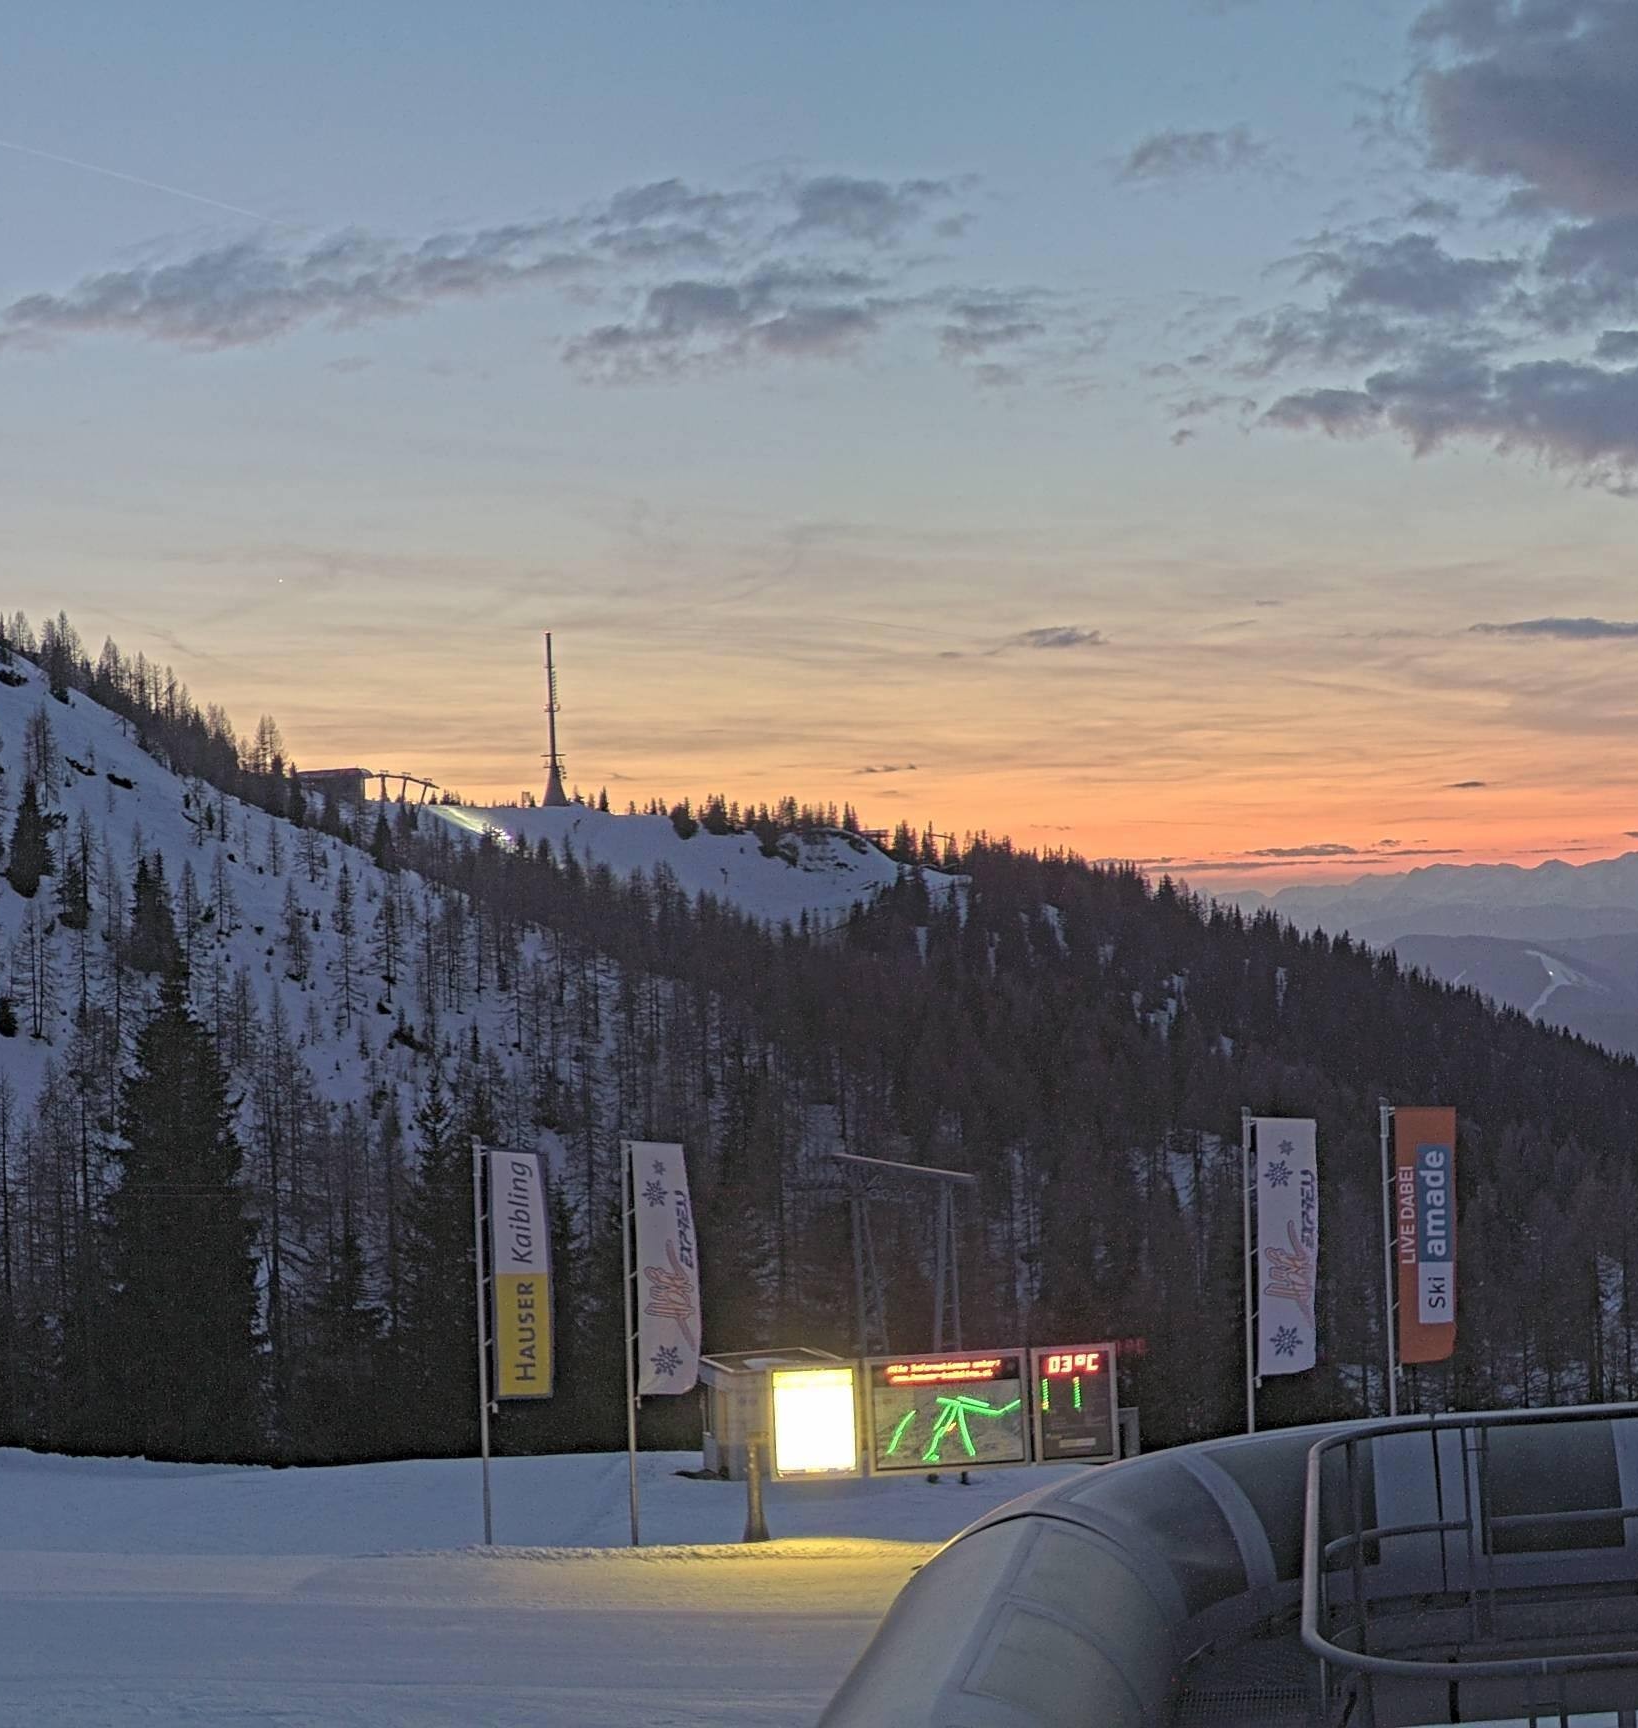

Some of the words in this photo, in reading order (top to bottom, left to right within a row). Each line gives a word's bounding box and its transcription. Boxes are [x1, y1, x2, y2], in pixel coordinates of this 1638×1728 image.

[508, 1160, 533, 1264] Kaibling
[1398, 1166, 1416, 1220] DABEI
[1401, 1223, 1416, 1265] LIVE
[1428, 1276, 1447, 1310] Ski
[515, 1281, 537, 1382] HAUSER
